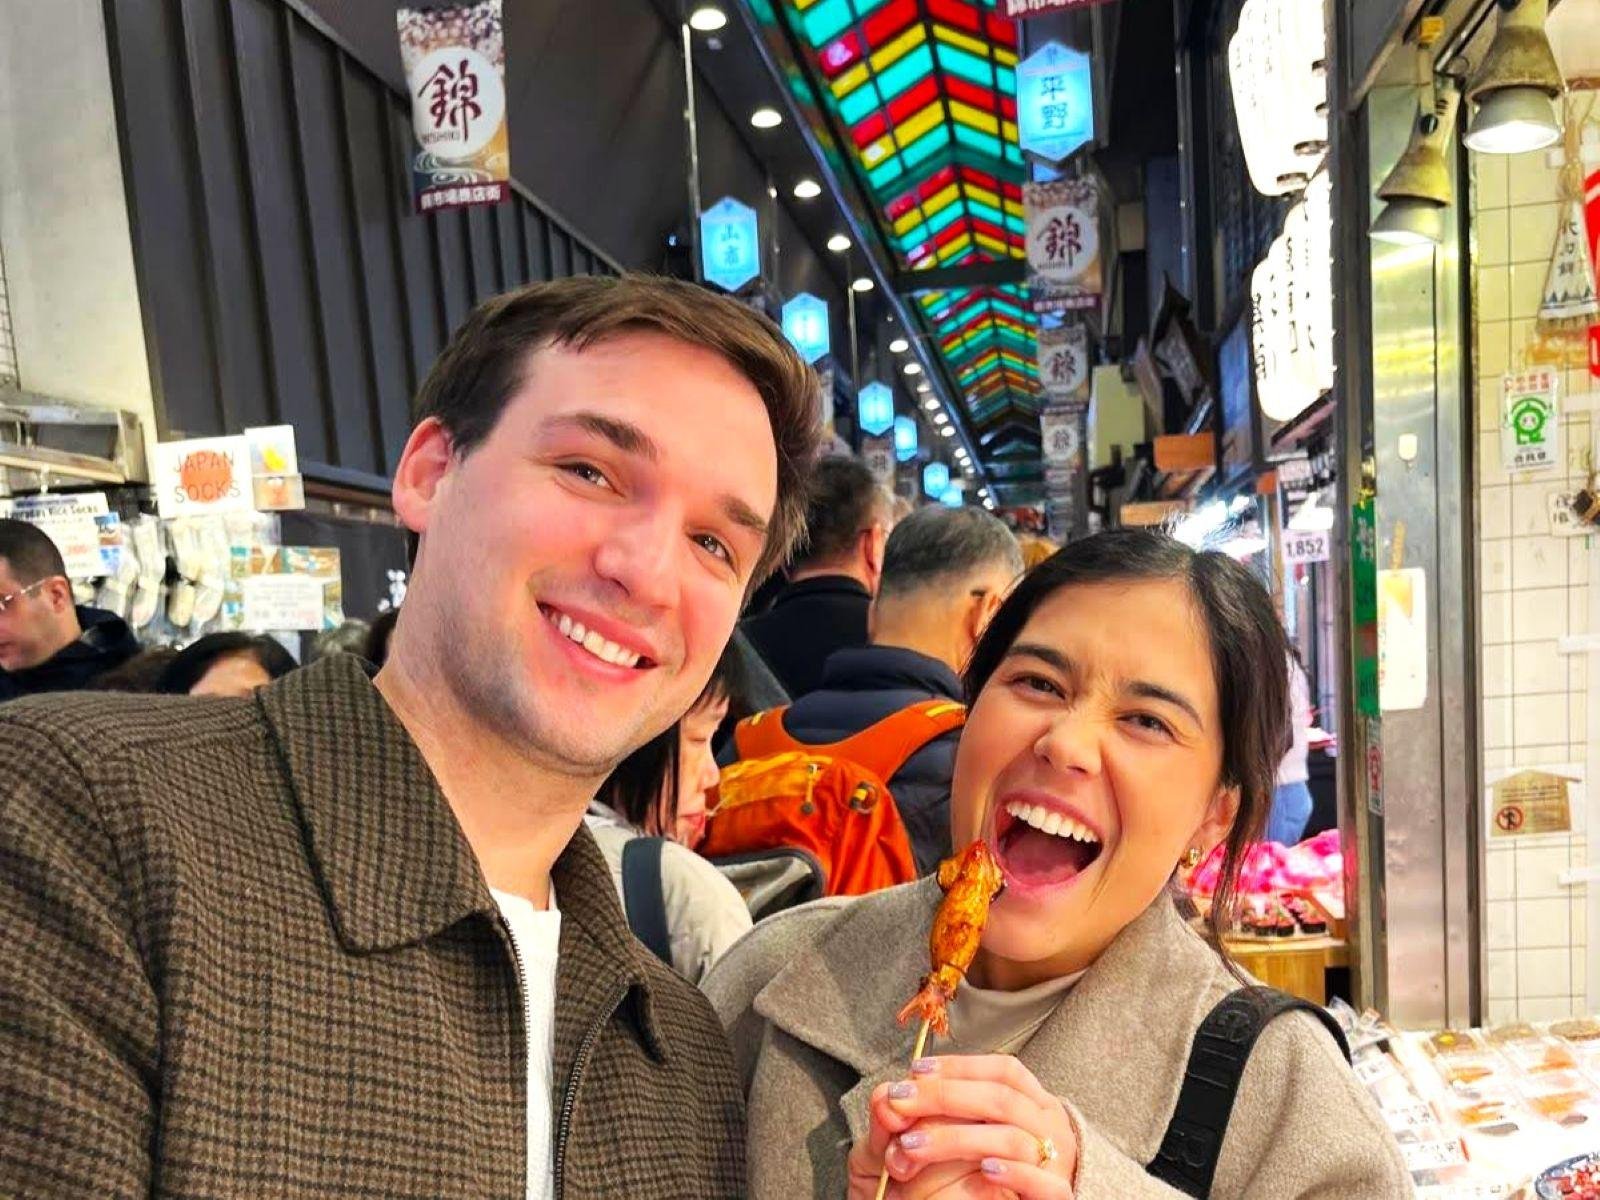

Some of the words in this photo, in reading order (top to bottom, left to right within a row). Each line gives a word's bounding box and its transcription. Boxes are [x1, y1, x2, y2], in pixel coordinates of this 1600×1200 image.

[418, 58, 482, 142] 錦
[1041, 75, 1068, 130] 平野
[174, 450, 234, 473] JAPAN
[174, 480, 240, 504] SOCKS
